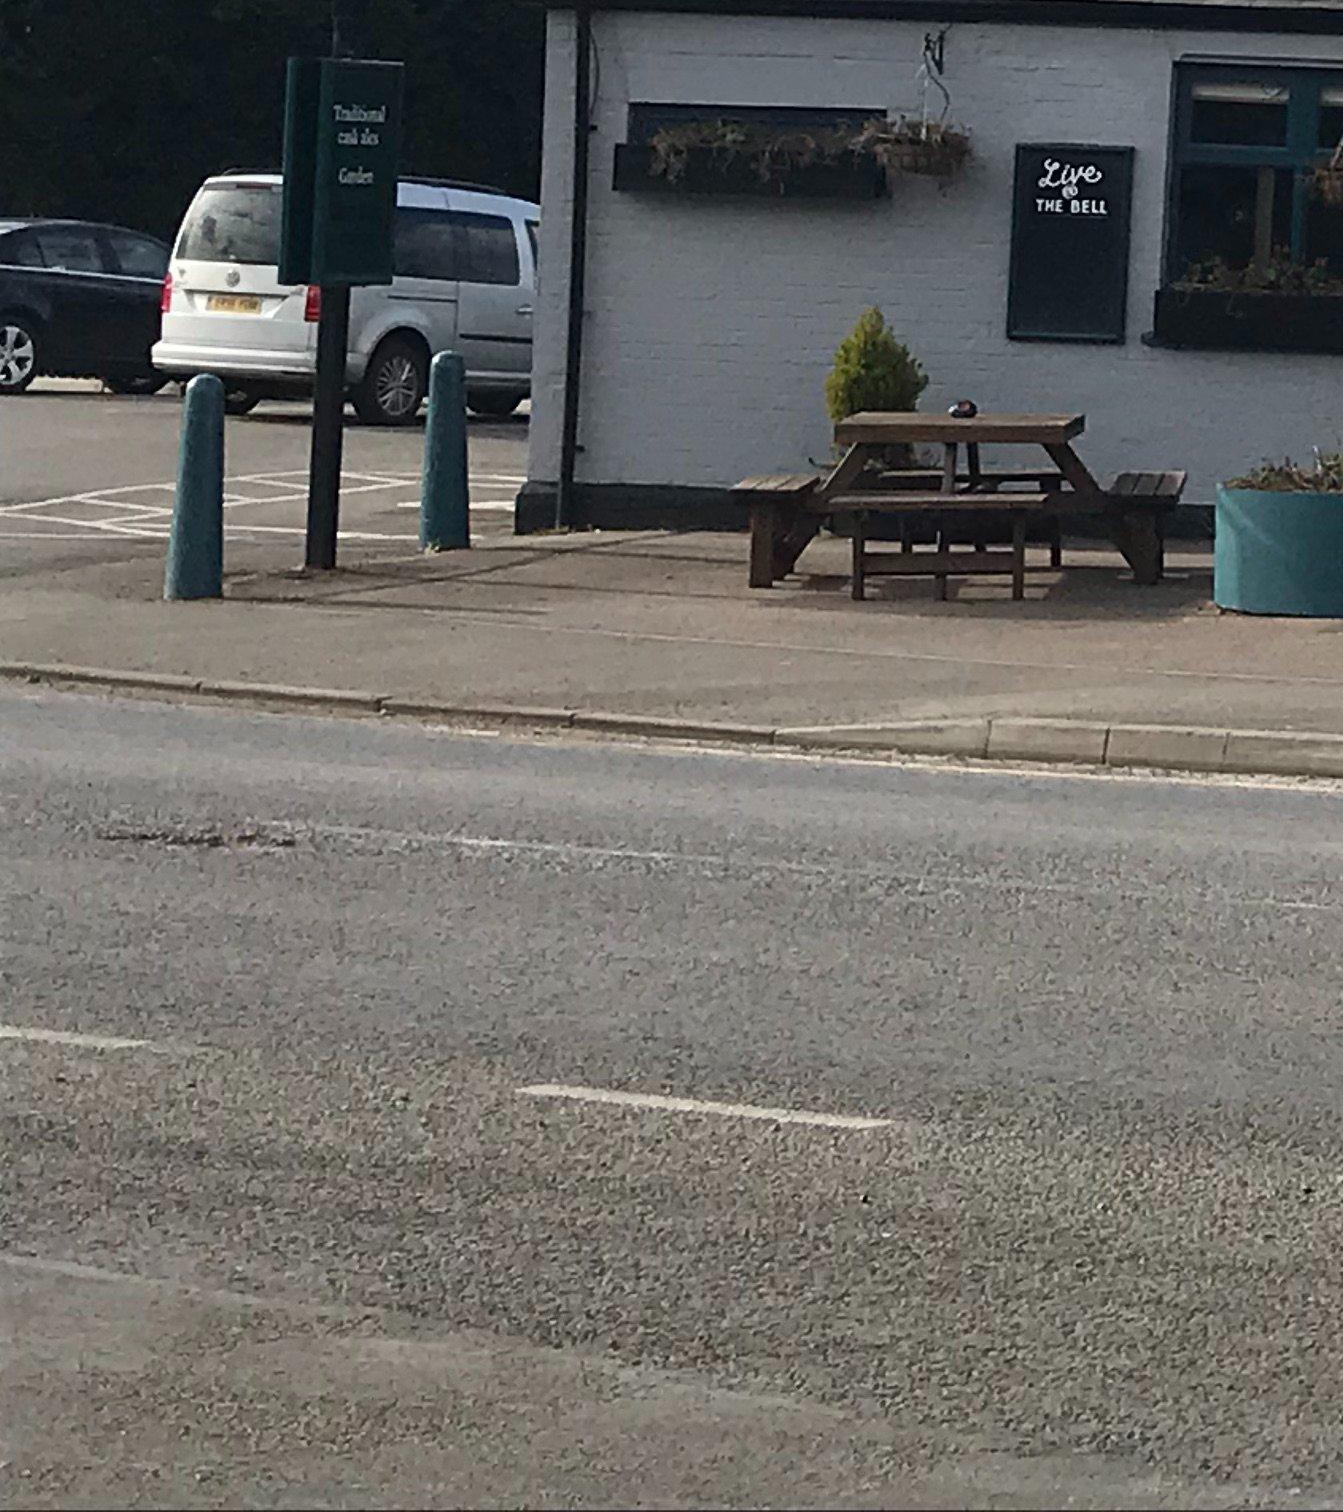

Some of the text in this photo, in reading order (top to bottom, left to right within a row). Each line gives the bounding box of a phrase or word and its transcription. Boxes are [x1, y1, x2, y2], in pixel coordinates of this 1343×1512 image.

[1038, 158, 1103, 188] Live
[1036, 198, 1108, 214] THE BELL
